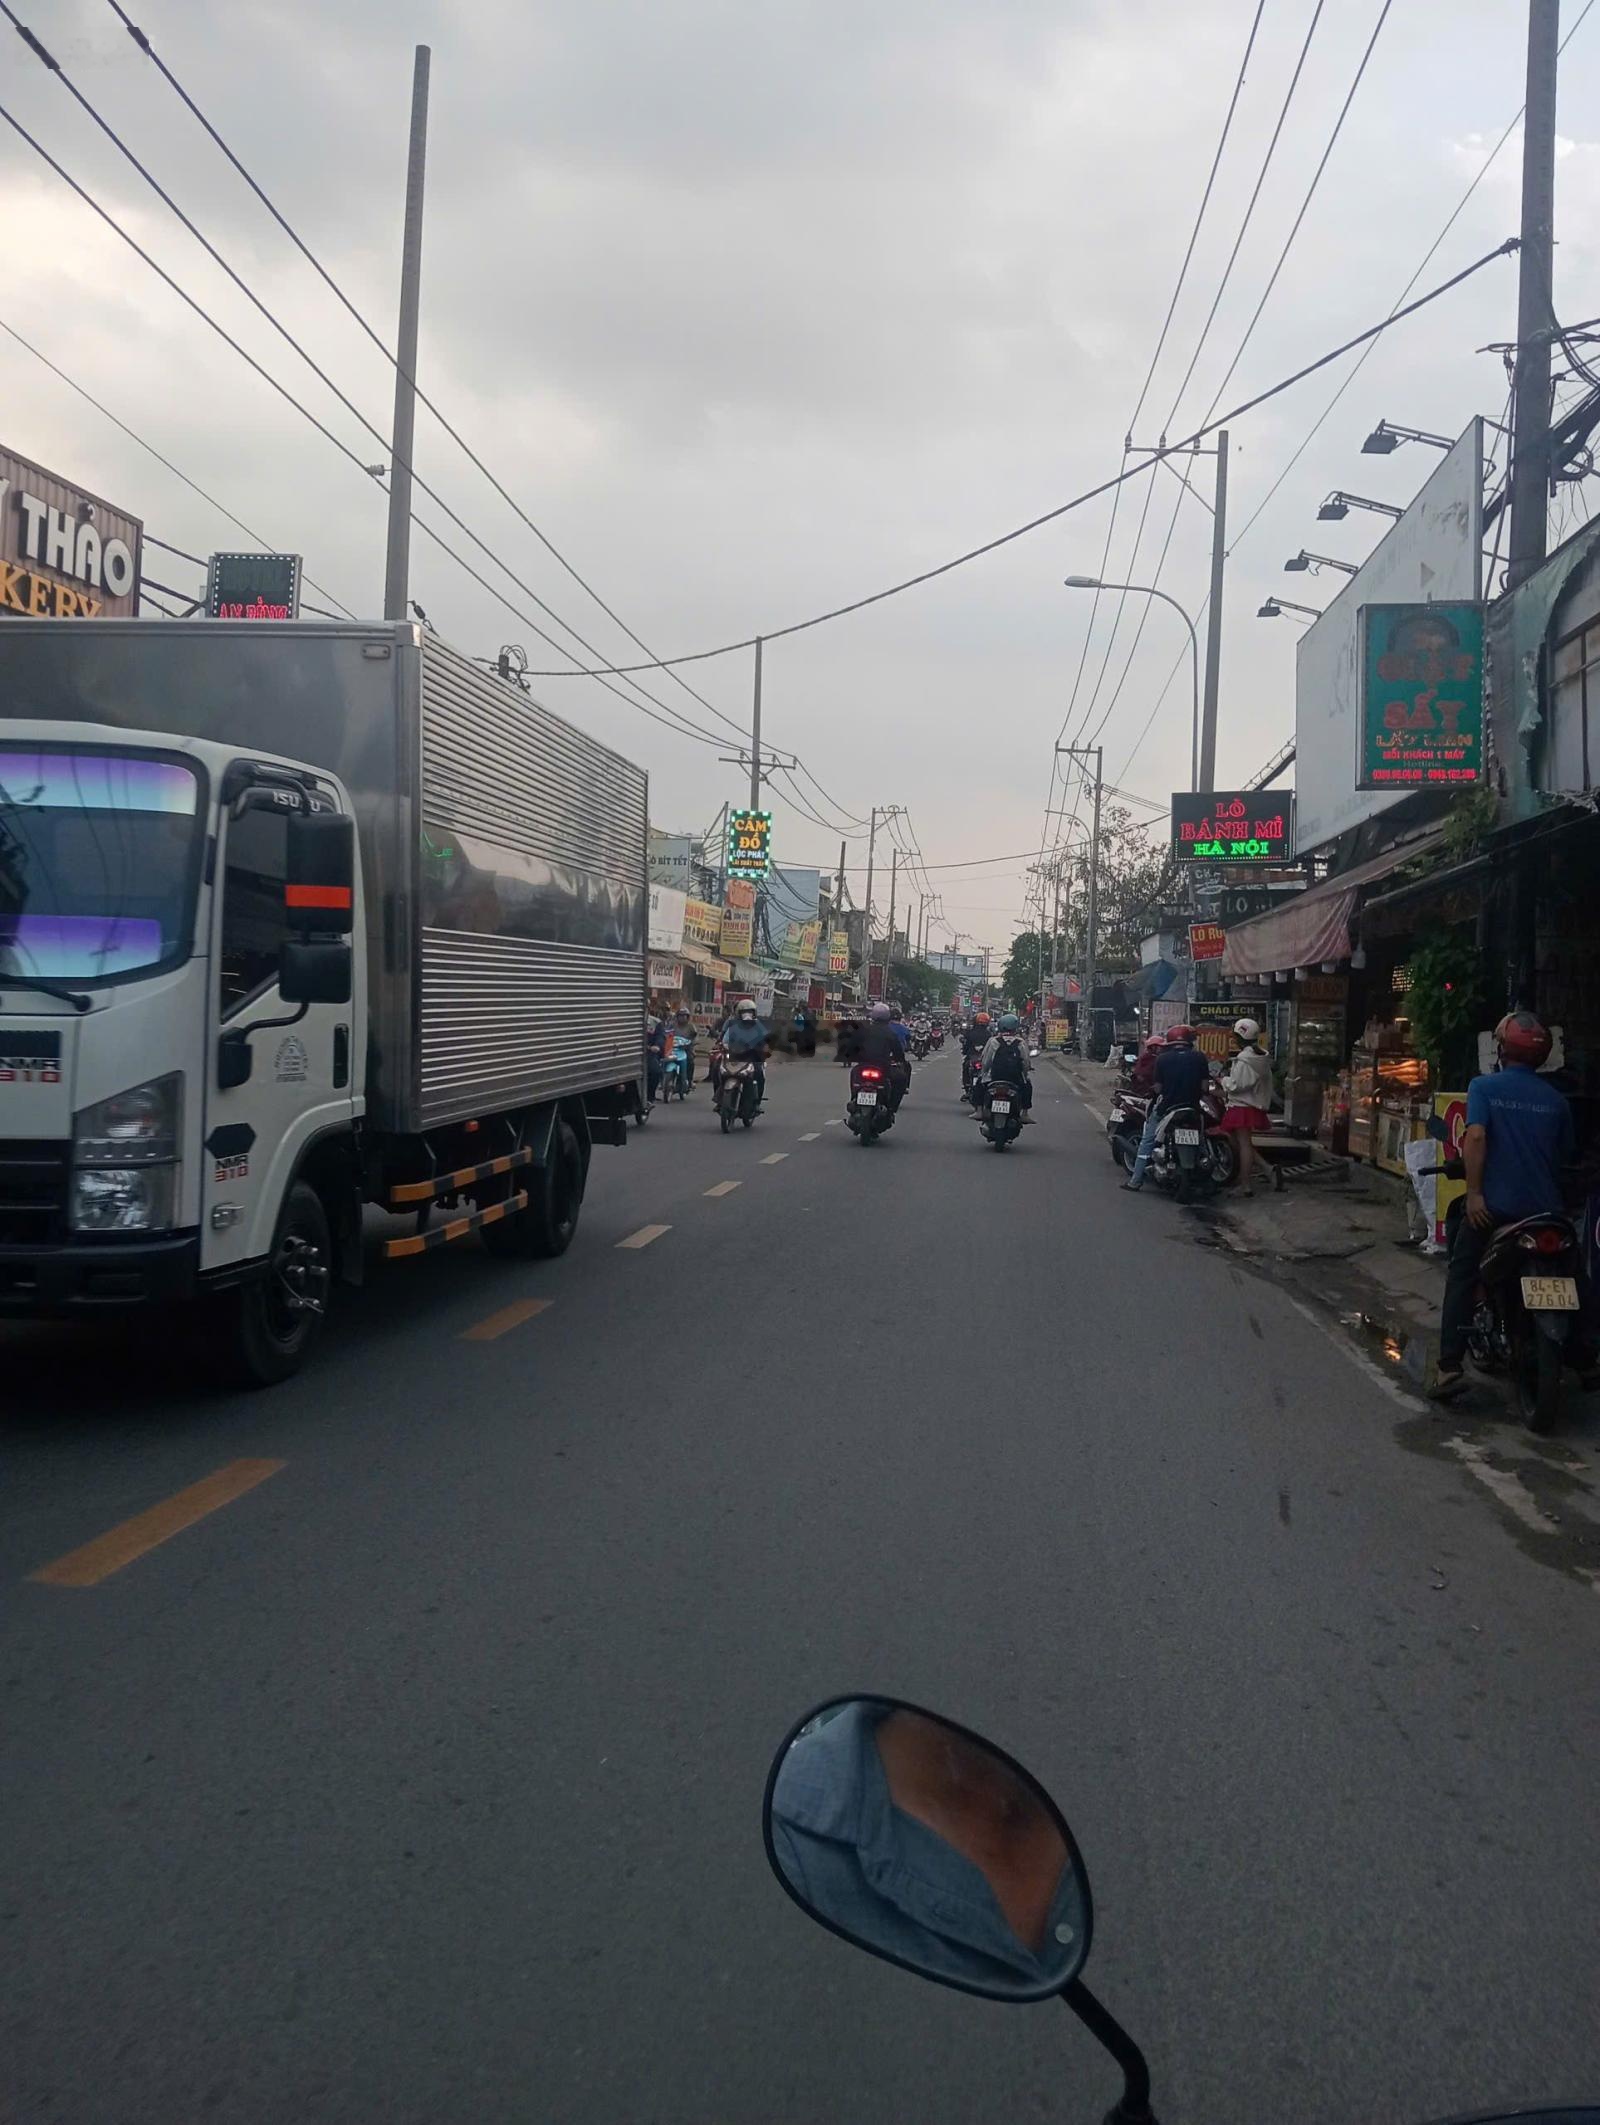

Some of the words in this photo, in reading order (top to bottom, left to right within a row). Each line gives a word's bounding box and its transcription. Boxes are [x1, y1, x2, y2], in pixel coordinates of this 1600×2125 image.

[22, 492, 134, 597] THẢO
[273, 791, 320, 812] ISUU
[1180, 817, 1248, 841] BÁNH
[1193, 839, 1225, 856] HÀ
[1230, 838, 1269, 857] NỘI
[214, 1155, 249, 1170] NMR
[214, 1166, 249, 1183] 310
[1529, 1279, 1567, 1293] 84-E1
